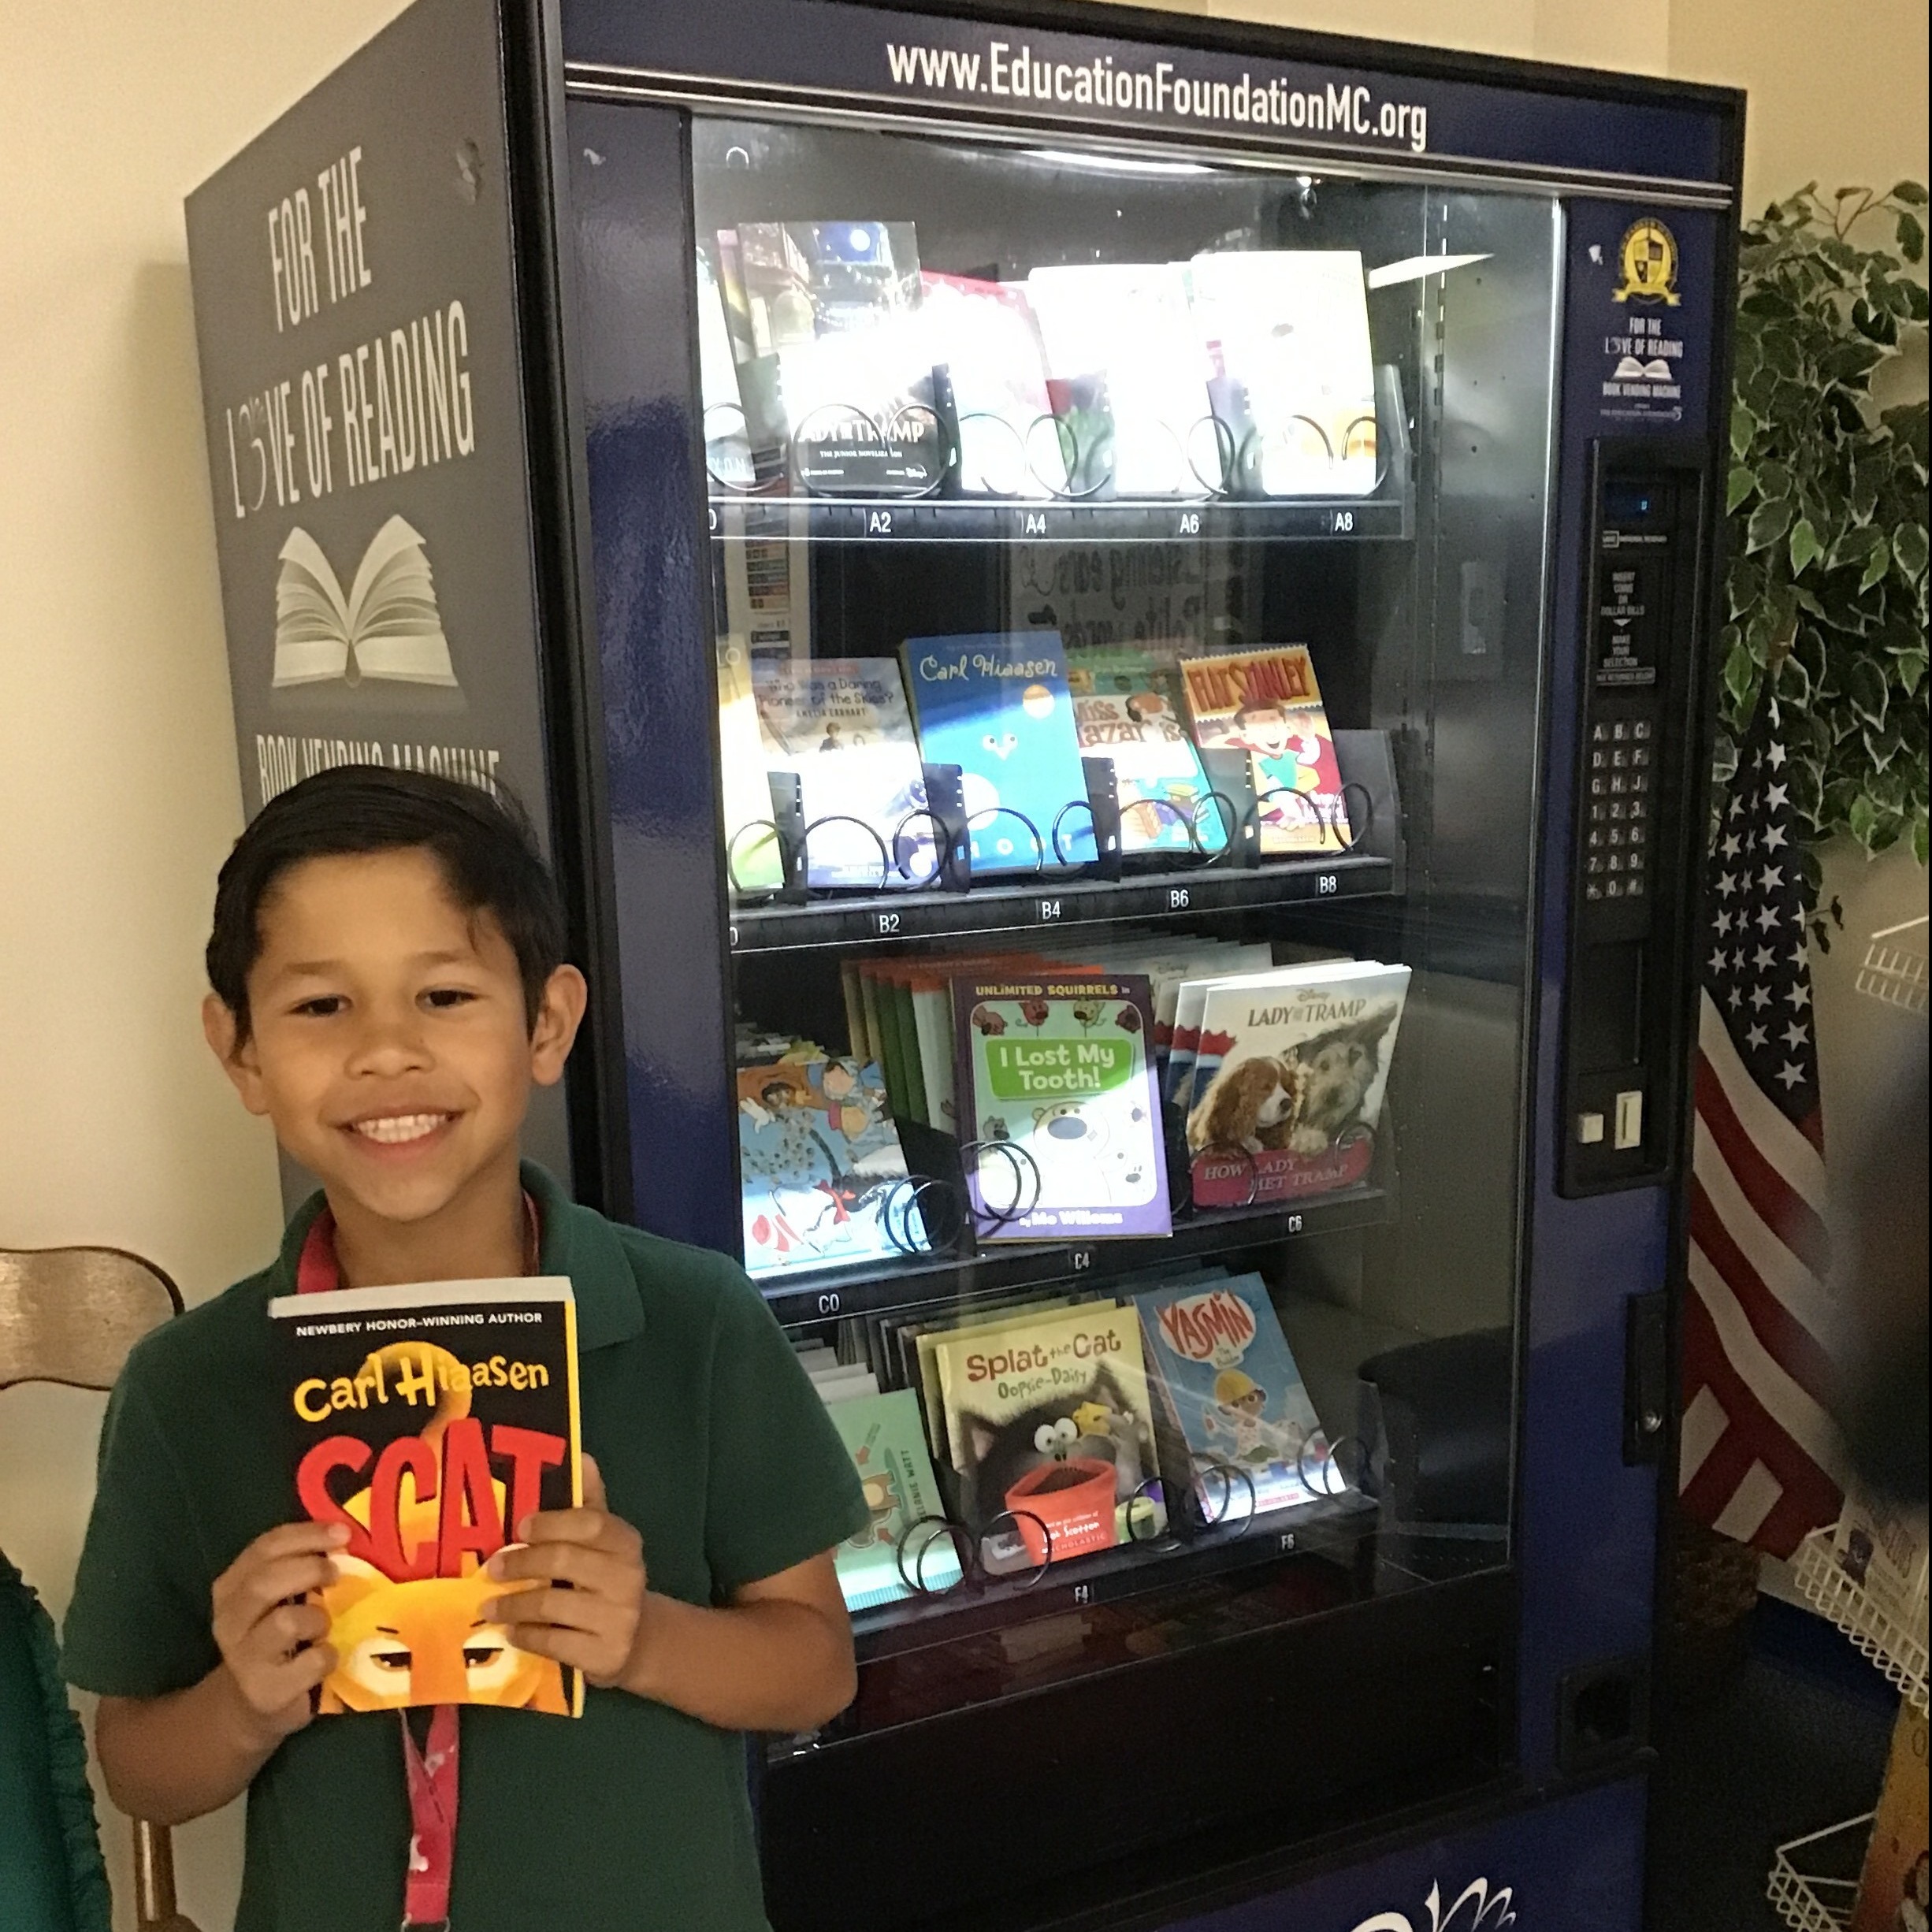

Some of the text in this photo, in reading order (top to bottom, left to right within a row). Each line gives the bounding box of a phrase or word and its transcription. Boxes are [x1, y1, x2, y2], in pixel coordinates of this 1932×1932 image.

[886, 42, 1427, 152] www.EducationFoundationMC.org
[268, 146, 372, 333] FOR THE
[1634, 337, 1647, 355] OF
[302, 364, 333, 498] OF
[339, 300, 474, 486] READING
[869, 511, 892, 533] A2
[1026, 513, 1046, 534] A4
[1180, 512, 1200, 534] A6
[1335, 512, 1354, 532] A8
[920, 654, 1058, 682] Carl Hiaasen
[828, 680, 836, 690] a
[838, 678, 881, 692] Daring
[1187, 656, 1311, 712] FLAT STANLEY
[811, 692, 826, 705] of
[830, 692, 851, 704] the
[854, 692, 894, 704] Skies?
[1593, 723, 1644, 741] A B C
[1592, 749, 1642, 767] D E F
[1591, 775, 1641, 794] G H J
[1592, 801, 1640, 819] 1 2 3
[1589, 827, 1639, 845] 4 5 6
[1590, 853, 1638, 871] 7 8 9
[1319, 875, 1337, 894] B8
[1609, 879, 1617, 896] 0
[1171, 889, 1190, 908] B6
[1042, 901, 1061, 920] B4
[879, 914, 900, 934] B2
[975, 984, 1043, 996] UNLIMITED
[1047, 984, 1118, 997] SQUIRRELS
[1248, 1005, 1294, 1027] LADY
[1306, 998, 1367, 1023] TRAMP
[999, 1043, 1116, 1070] I Lost My
[1018, 1065, 1101, 1091] Tooth!
[1204, 1164, 1247, 1180] HOW
[1293, 1164, 1348, 1187] TRAMP
[1031, 1211, 1057, 1226] Mo
[1288, 1215, 1303, 1233] C6
[1074, 1251, 1090, 1270] C4
[296, 1311, 543, 1336] NEWBERY HONOR-WINNING AUTHOR
[1154, 1288, 1254, 1359] YASMIN
[966, 1328, 1122, 1383] Splat the Cat
[294, 1347, 549, 1422] Carl Hiaasen
[998, 1365, 1087, 1399] Oopsie-Daisy
[296, 1417, 567, 1584] SCAT
[1281, 1533, 1295, 1551] F6
